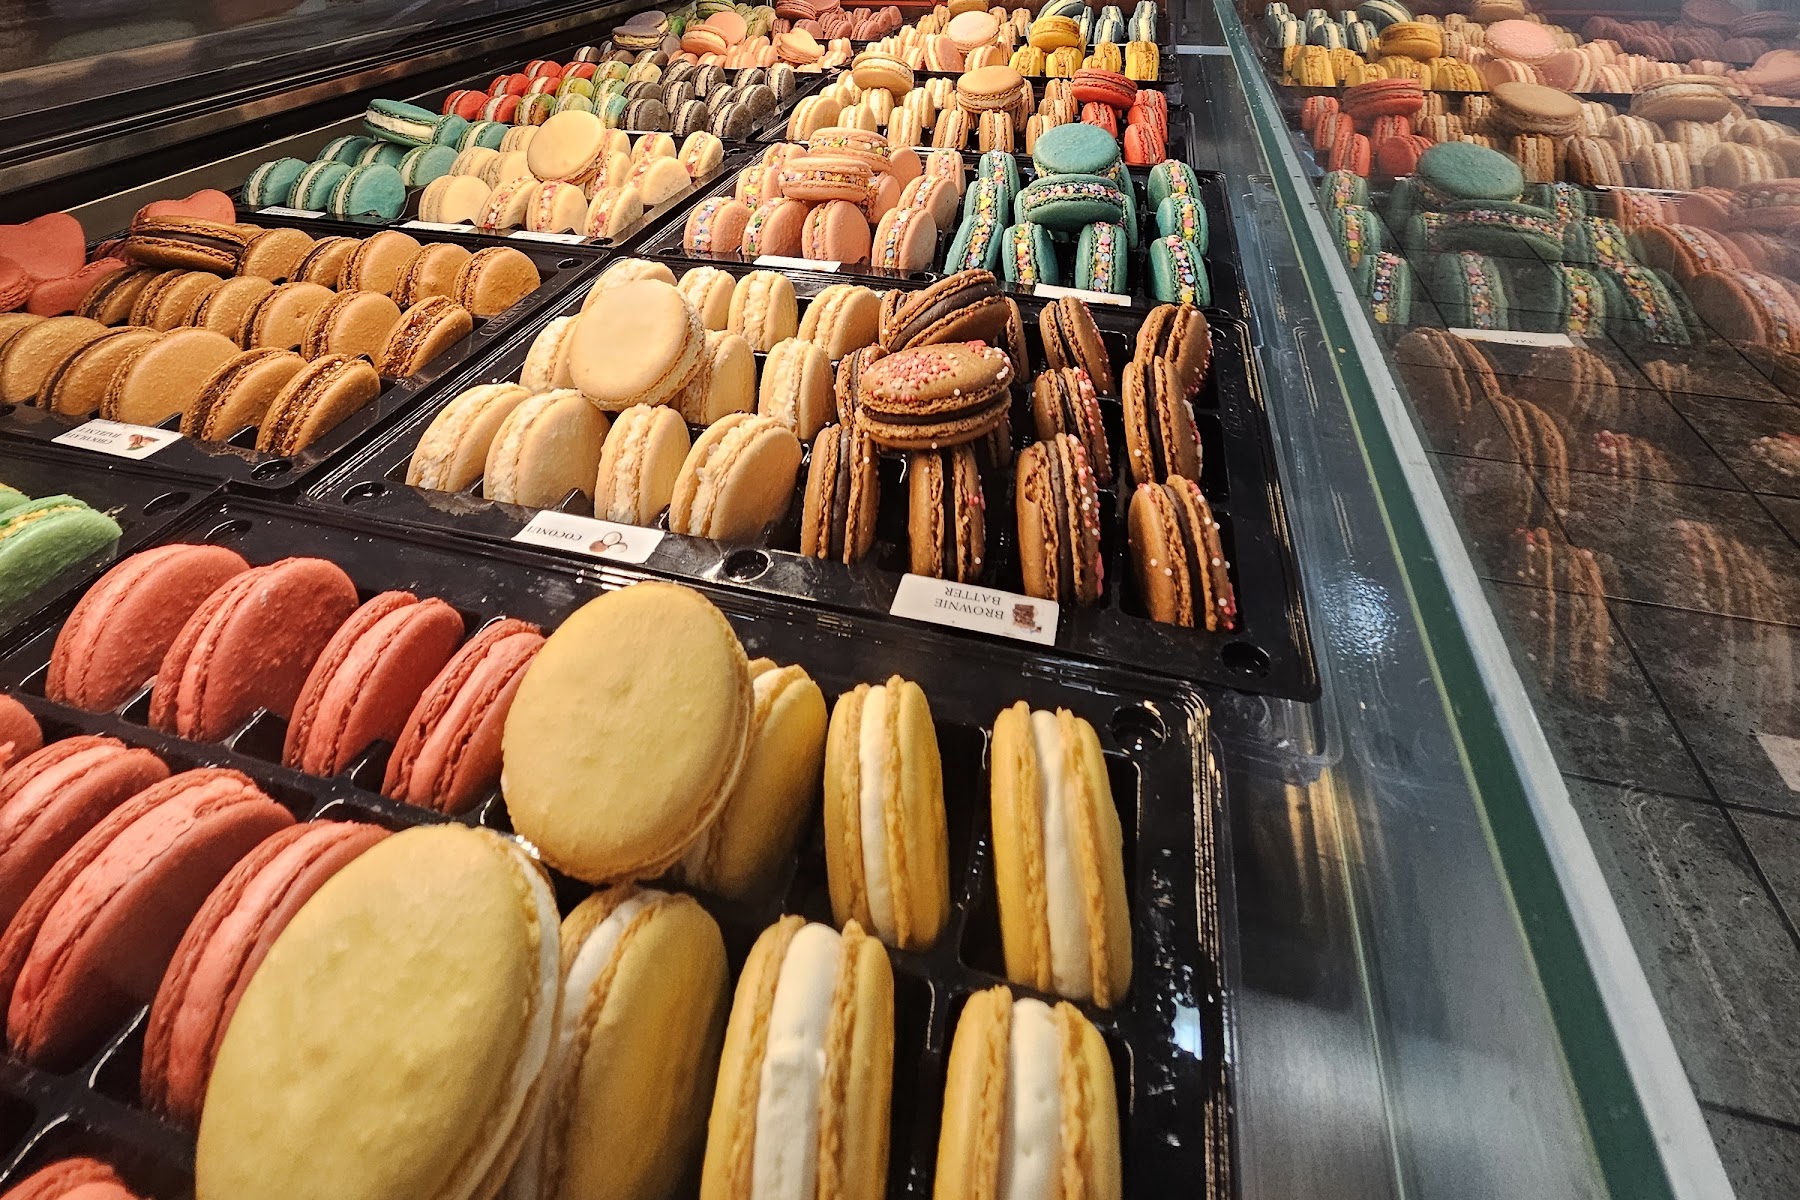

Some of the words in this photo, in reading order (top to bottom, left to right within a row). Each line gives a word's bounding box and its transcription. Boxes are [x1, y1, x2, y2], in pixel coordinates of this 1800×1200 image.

[526, 525, 583, 542] COCONUT
[944, 586, 1002, 606] BATTER
[934, 597, 1005, 620] BROWNIE
